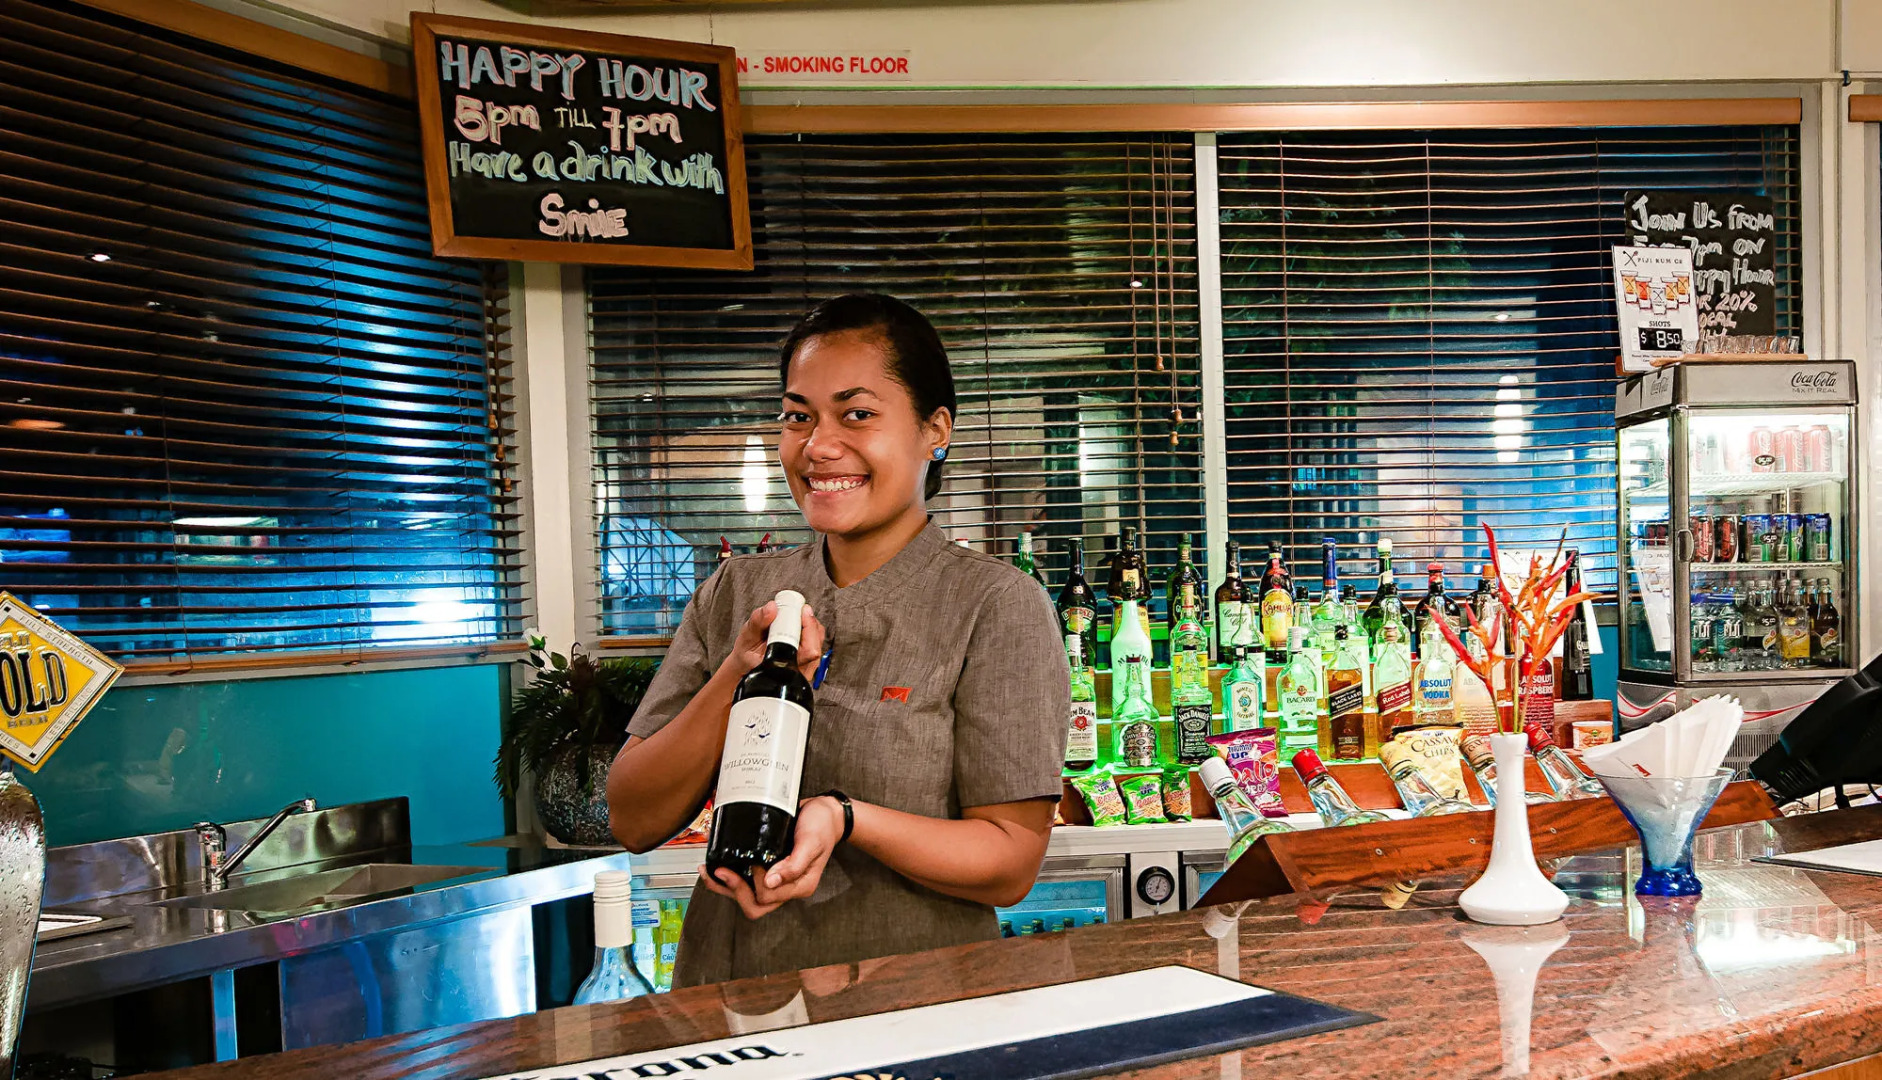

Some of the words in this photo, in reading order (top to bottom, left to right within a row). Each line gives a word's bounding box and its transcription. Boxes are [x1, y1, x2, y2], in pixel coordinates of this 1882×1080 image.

[764, 56, 844, 73] SMOKING
[850, 57, 909, 73] FLOOR
[441, 41, 586, 100] HAPPY
[598, 58, 716, 112] HOUR
[454, 95, 540, 145] 5pm
[602, 106, 682, 151] 7pm
[450, 141, 528, 182] Have
[661, 152, 724, 195] with
[1733, 237, 1766, 256] ON
[1715, 289, 1758, 312] 20%
[0, 649, 68, 718] OLD
[1420, 679, 1452, 688] ABSOLUT
[1520, 674, 1552, 684] ASOLUT
[1423, 691, 1450, 699] VODKA
